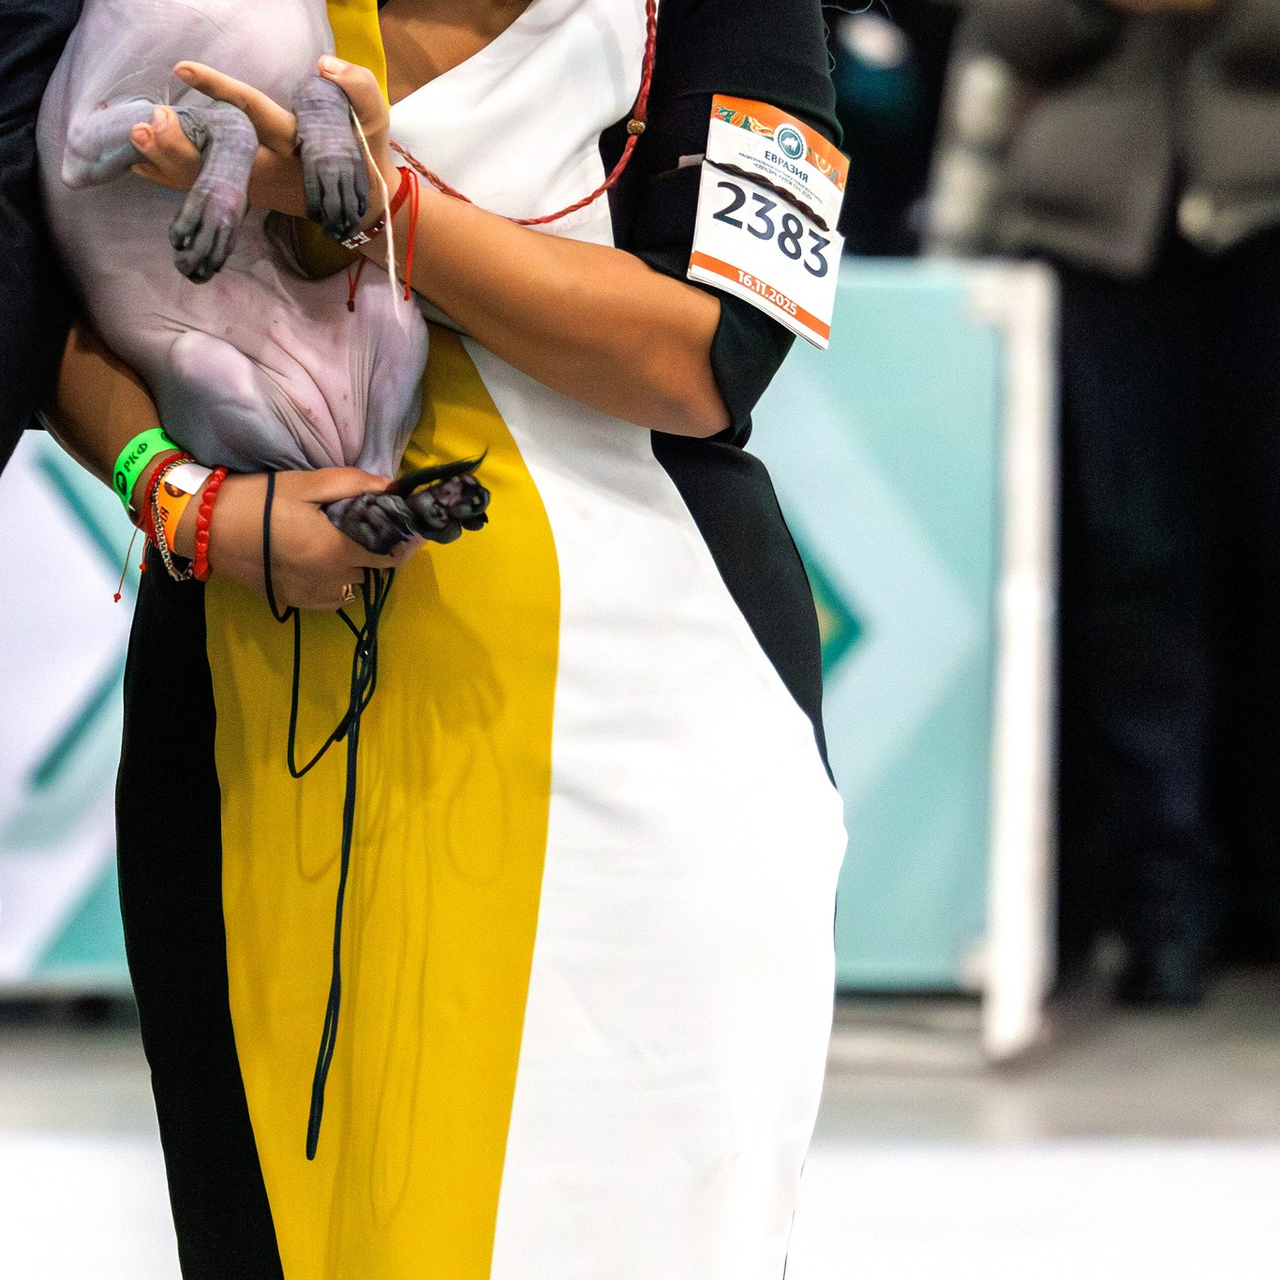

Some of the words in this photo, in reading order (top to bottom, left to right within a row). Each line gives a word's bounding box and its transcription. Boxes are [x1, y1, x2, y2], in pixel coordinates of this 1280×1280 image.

[764, 149, 810, 184] ЕВРАЗИЯ
[712, 181, 831, 279] 2383
[737, 269, 797, 316] 16.11.2025
[123, 442, 148, 473] РКФ
